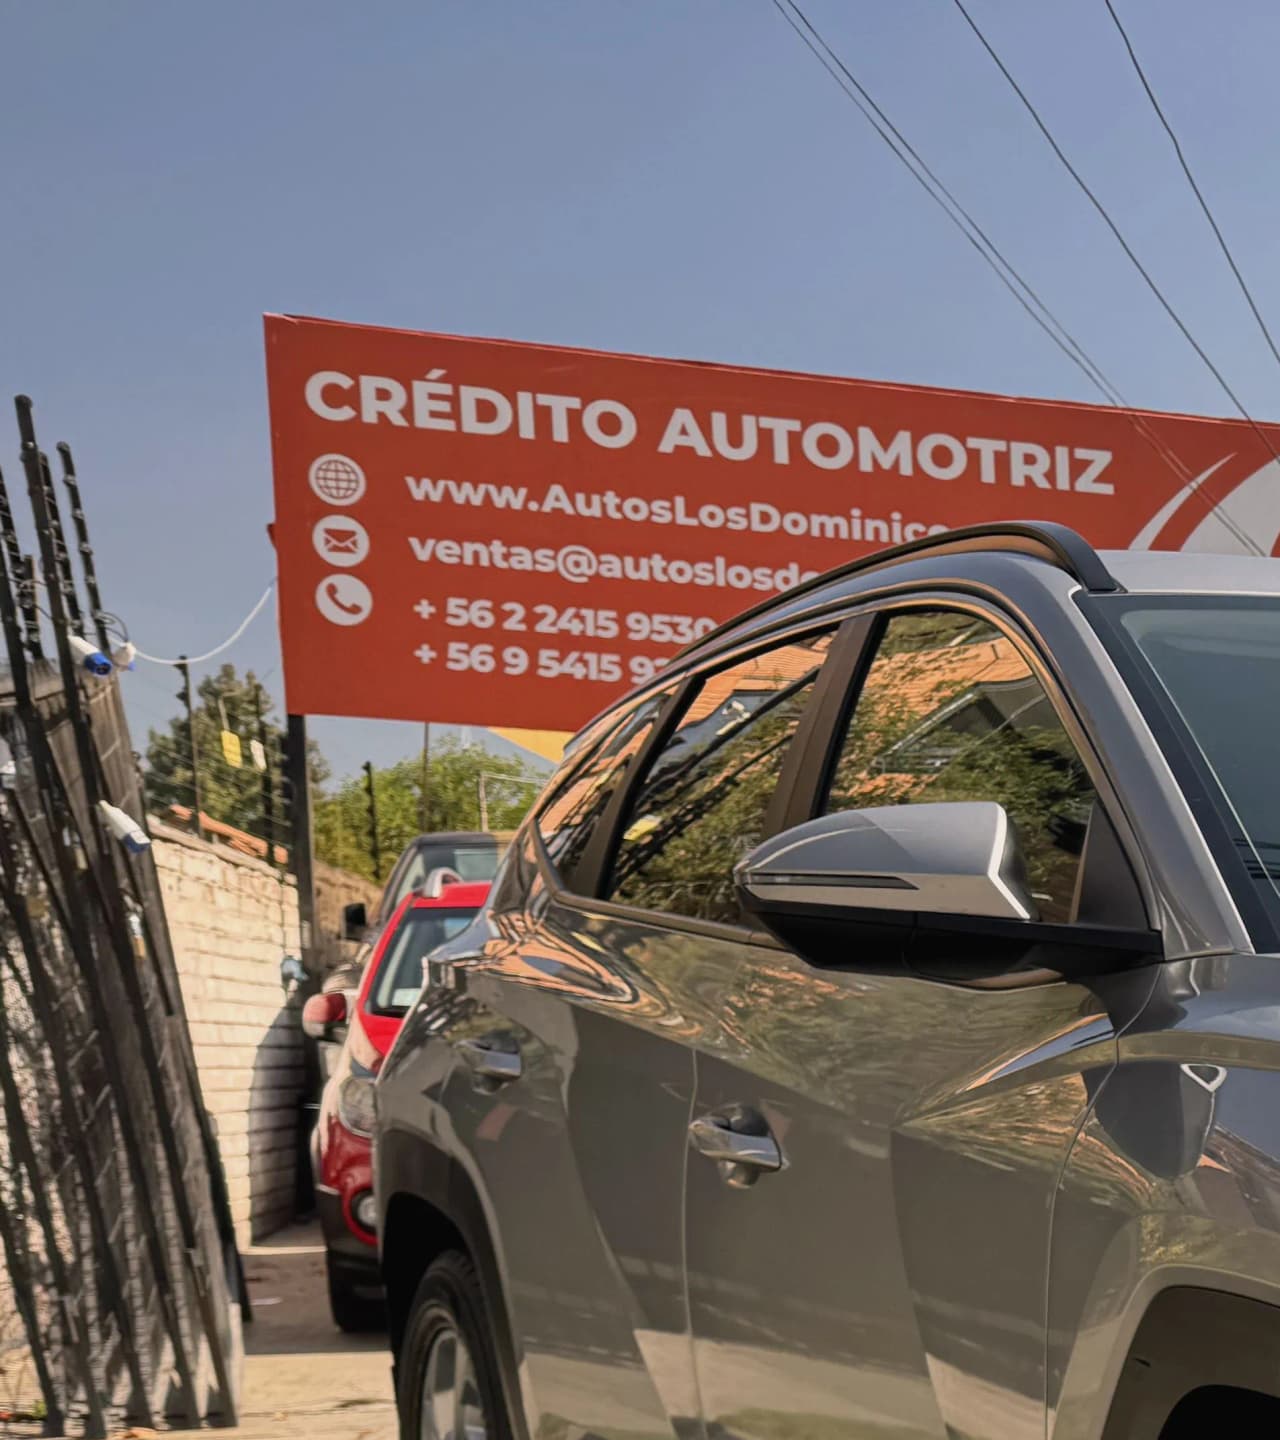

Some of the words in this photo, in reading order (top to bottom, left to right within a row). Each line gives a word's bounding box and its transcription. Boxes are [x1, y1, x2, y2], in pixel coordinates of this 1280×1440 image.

[304, 368, 638, 449] CRÉDITO
[657, 407, 1116, 495] AUTOMOTRIZ
[445, 597, 494, 629] 56
[501, 602, 527, 632] 2
[533, 605, 619, 640] 2415
[446, 642, 496, 673] 56
[502, 646, 529, 676] 9
[537, 649, 622, 682] 5415
[629, 655, 671, 687] 9
